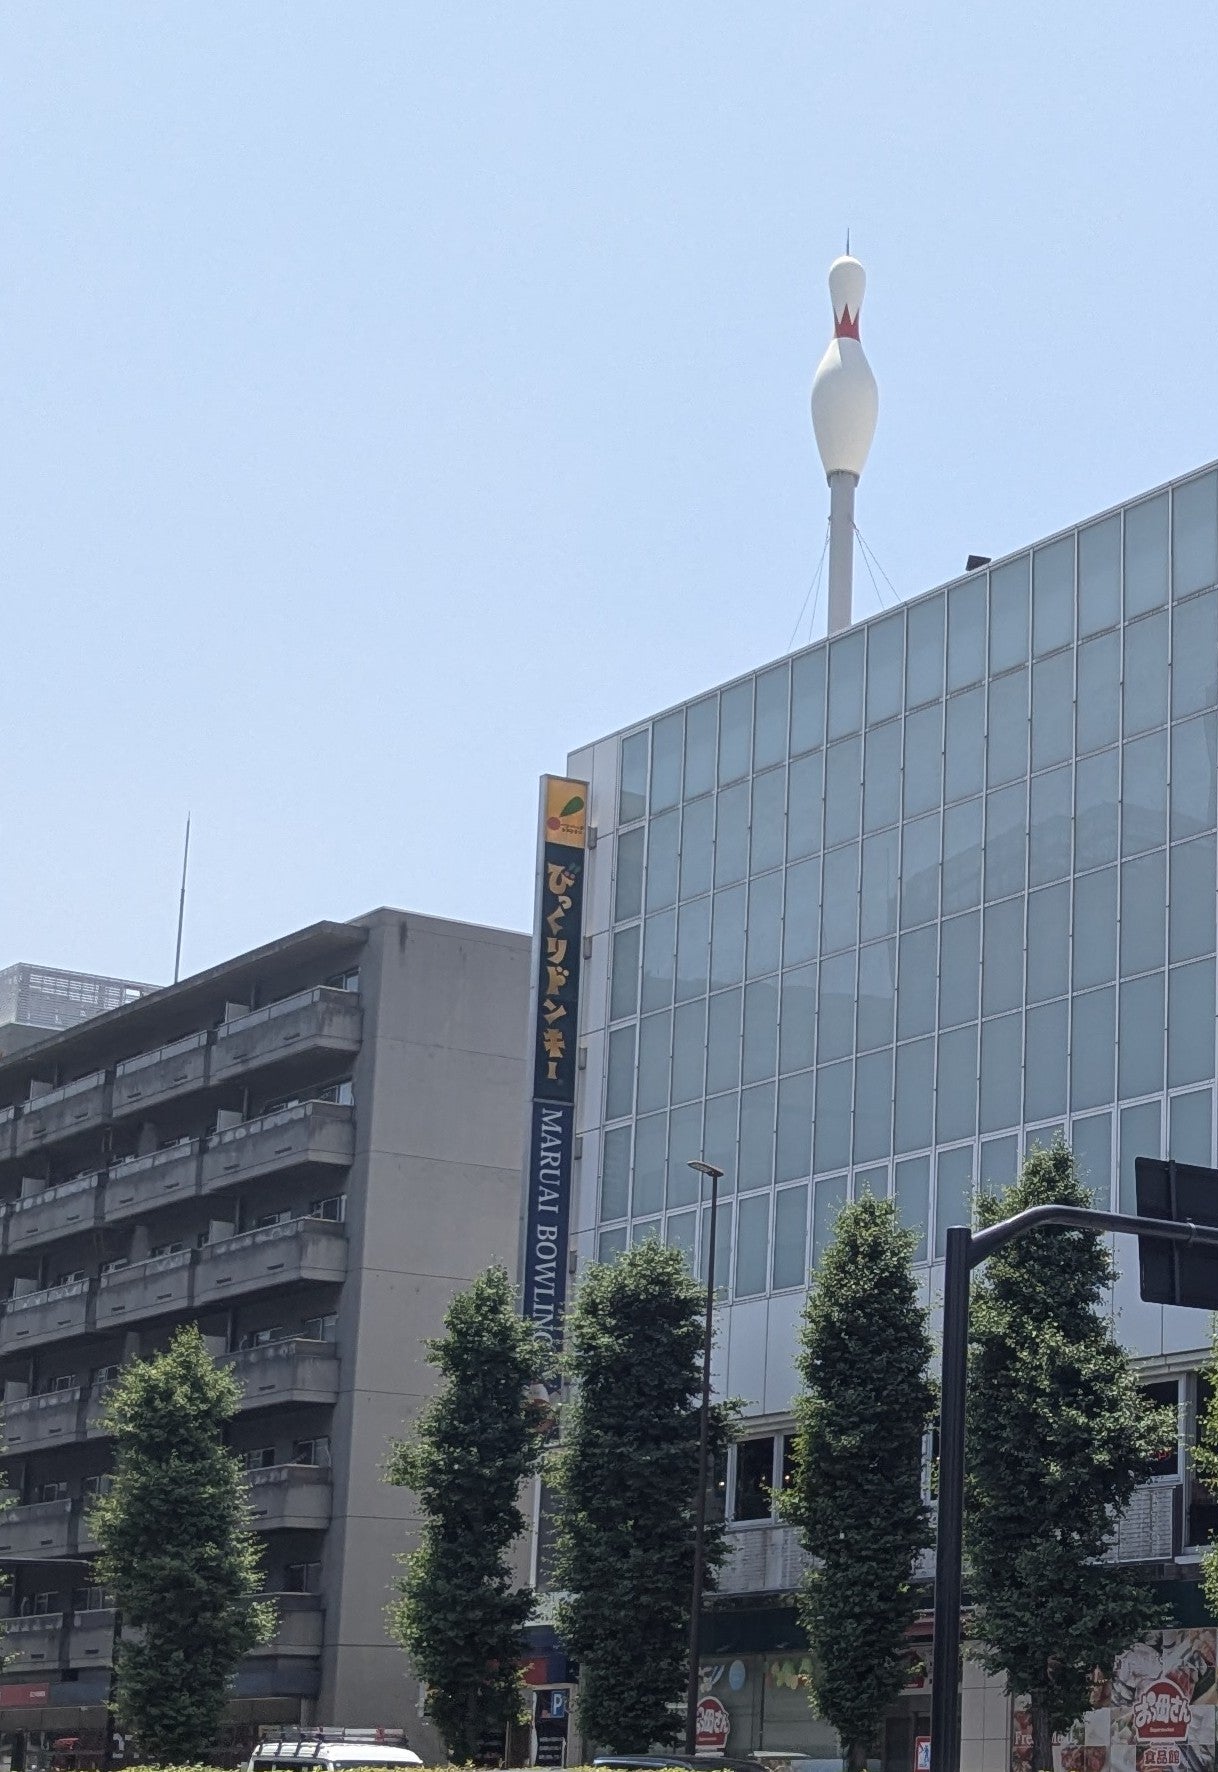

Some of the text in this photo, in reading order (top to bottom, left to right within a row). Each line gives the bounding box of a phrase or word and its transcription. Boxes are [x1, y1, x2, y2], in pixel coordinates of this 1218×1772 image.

[543, 862, 575, 1080] びっくりドンキー
[538, 1107, 563, 1214] MARUAI
[553, 1693, 564, 1715] P
